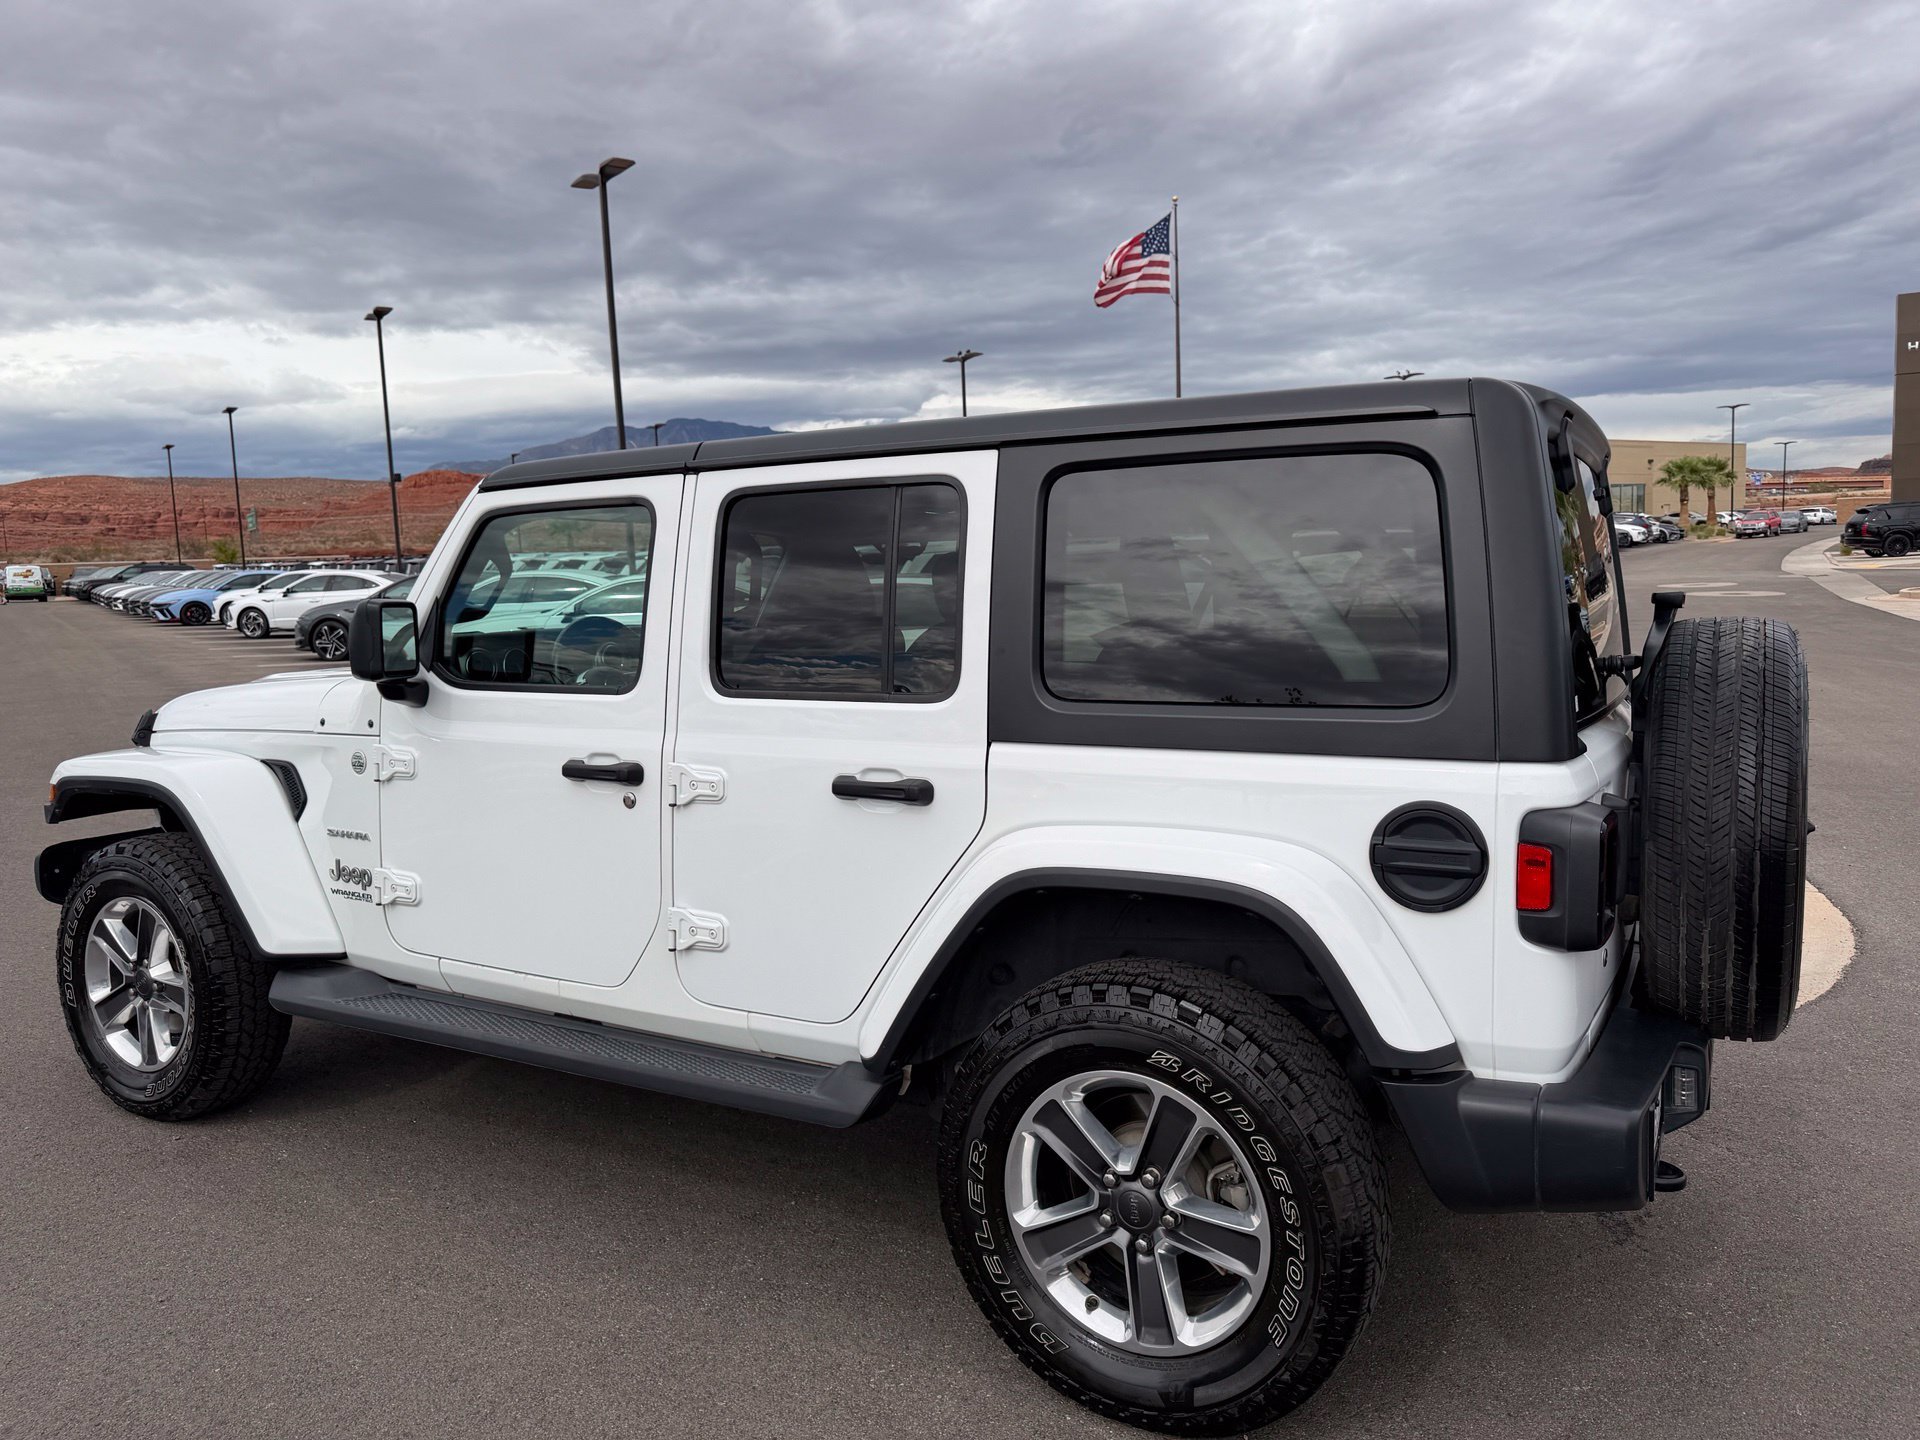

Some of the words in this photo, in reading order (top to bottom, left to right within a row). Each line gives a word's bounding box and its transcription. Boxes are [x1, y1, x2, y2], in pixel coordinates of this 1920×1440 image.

[327, 828, 371, 842] SAHARA
[329, 858, 373, 890] Jeep
[330, 887, 373, 900] WRANGLER
[62, 883, 97, 1008] DUELER
[1146, 1050, 1306, 1348] BRIDGESTONE
[966, 1138, 1071, 1356] DUELER
